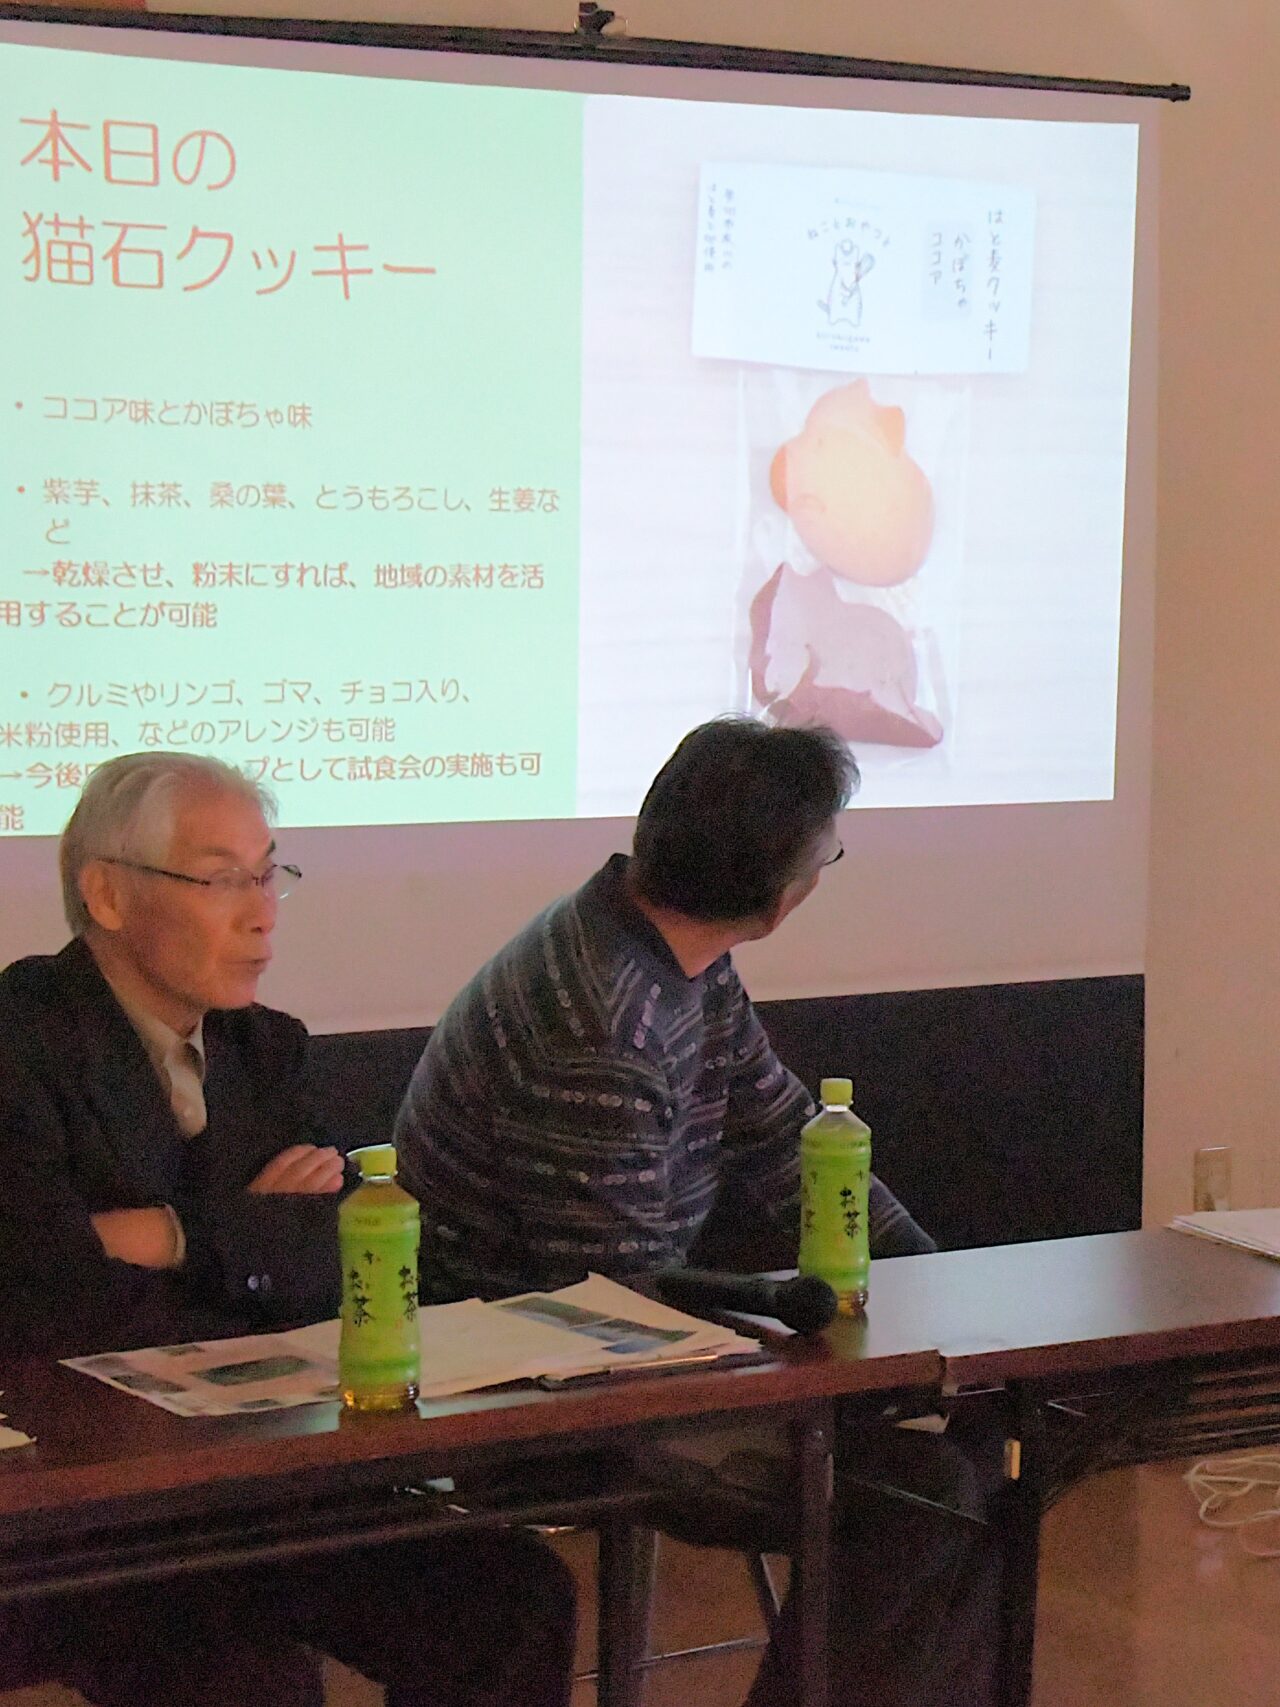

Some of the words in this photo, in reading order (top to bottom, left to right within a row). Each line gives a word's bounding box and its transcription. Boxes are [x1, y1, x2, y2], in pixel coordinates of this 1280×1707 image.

[18, 108, 237, 191] 本日の
[20, 210, 437, 300] 猫石クッキー
[43, 396, 313, 429] ココア味とかぼちゃ味
[45, 518, 71, 545] ど
[0, 600, 218, 629] 用することが可能
[0, 804, 25, 831] 能
